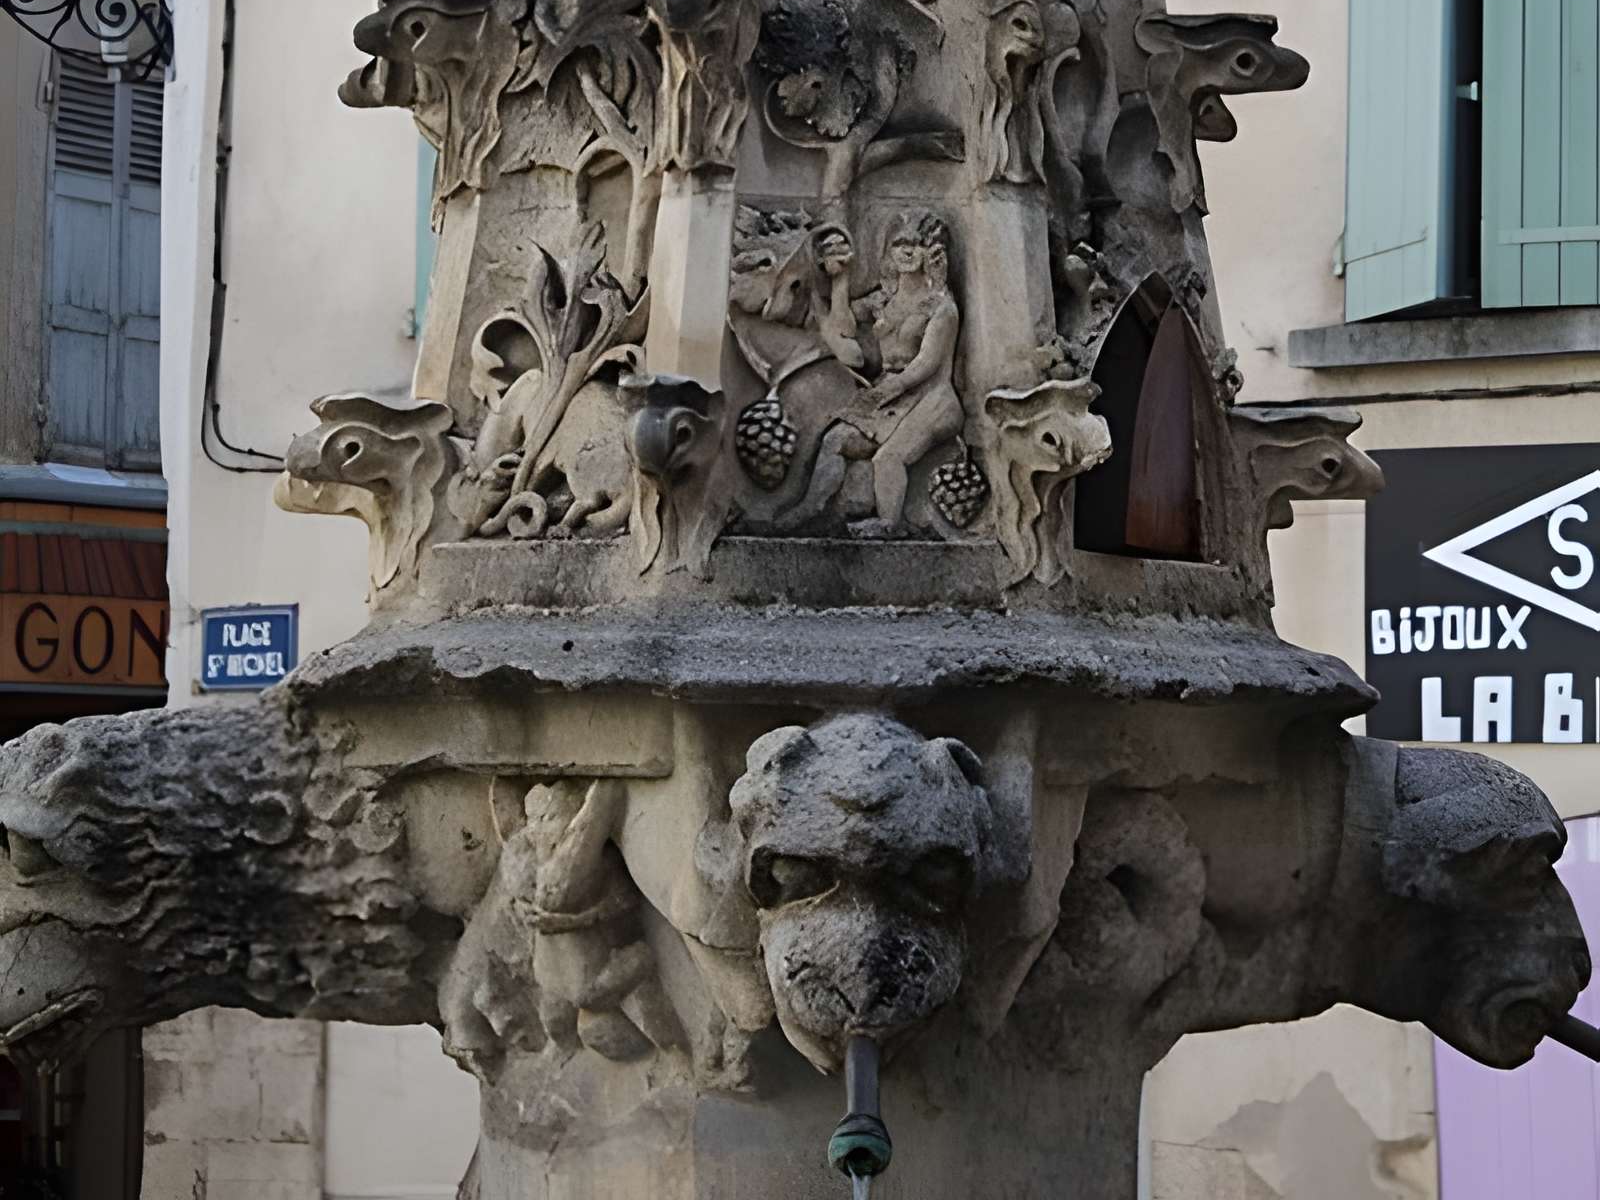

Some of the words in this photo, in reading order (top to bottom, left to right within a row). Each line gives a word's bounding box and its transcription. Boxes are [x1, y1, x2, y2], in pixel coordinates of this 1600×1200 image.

[15, 602, 167, 679] GON
[1421, 676, 1513, 743] LA
[1542, 672, 1600, 744] B
